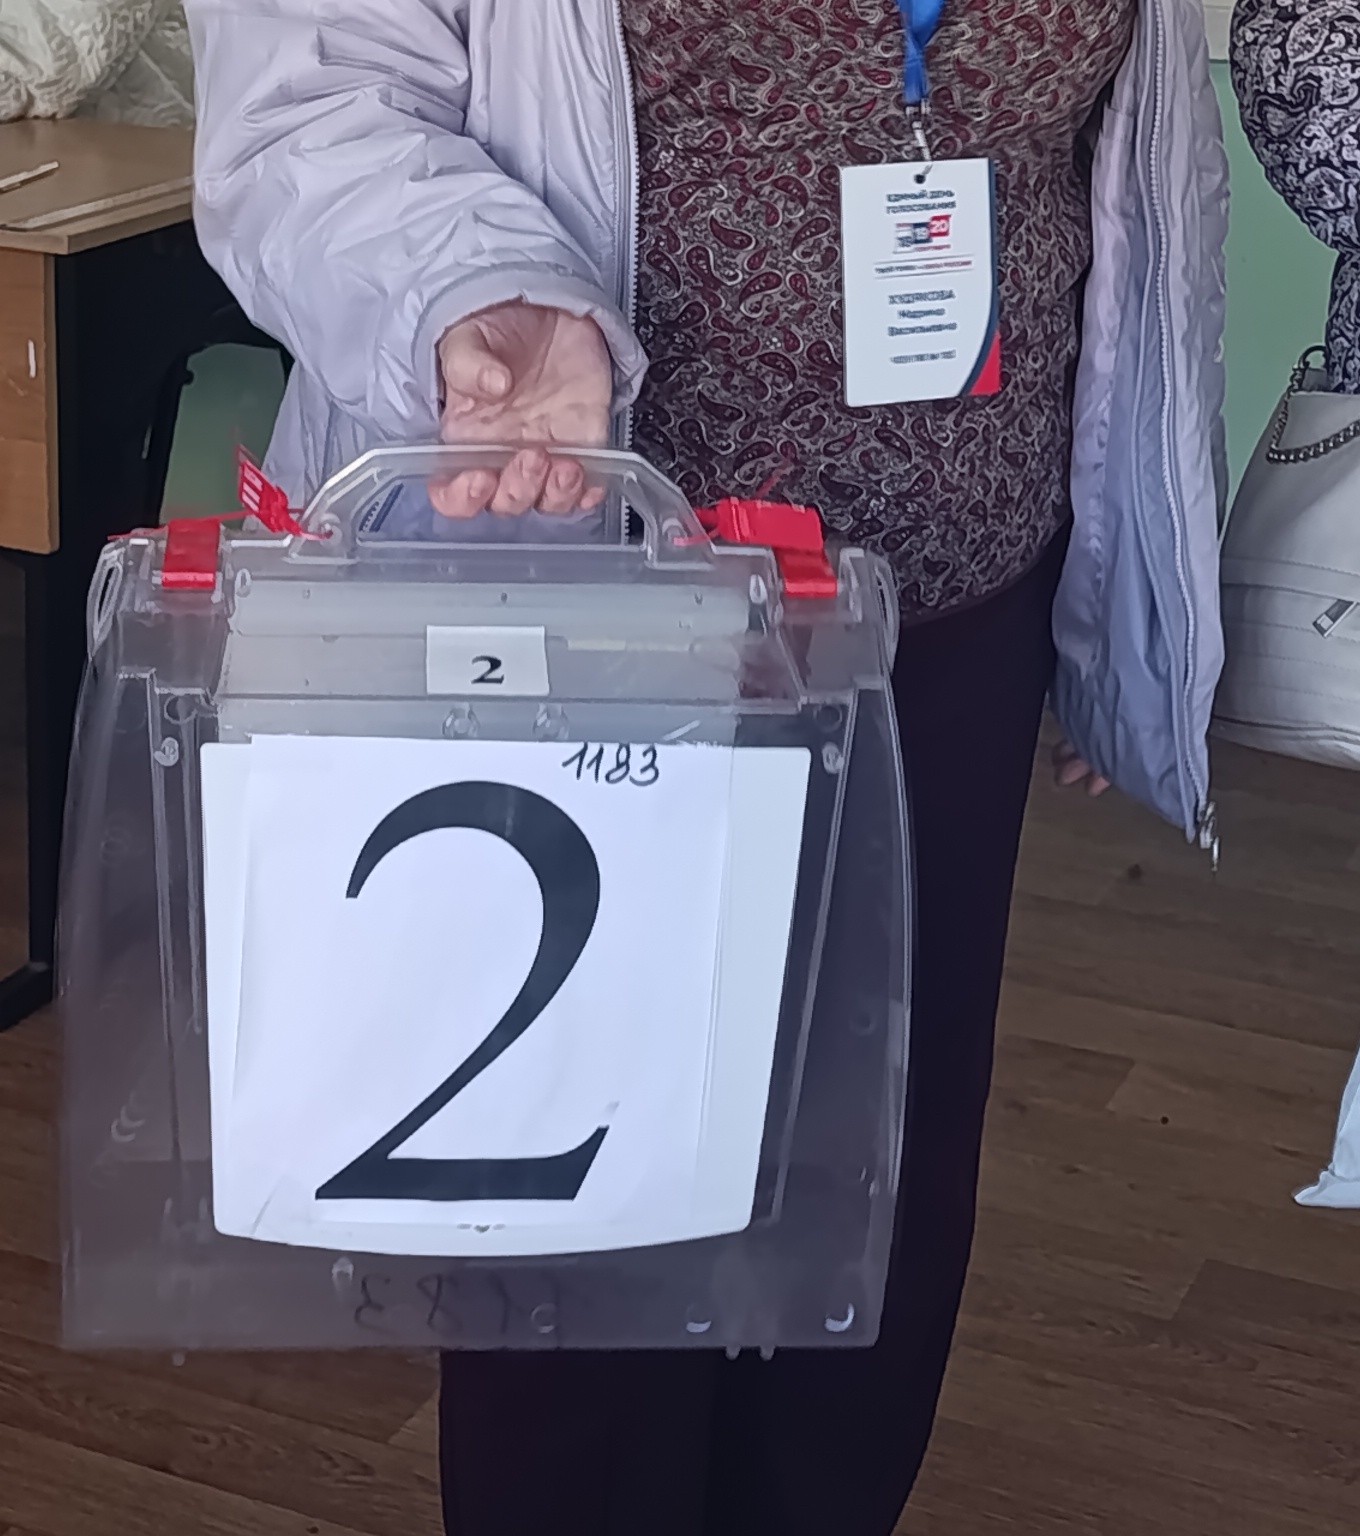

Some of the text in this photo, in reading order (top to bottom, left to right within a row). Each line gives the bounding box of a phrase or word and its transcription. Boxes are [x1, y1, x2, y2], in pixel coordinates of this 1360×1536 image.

[930, 220, 948, 233] 20
[471, 655, 504, 685] 2
[561, 740, 660, 787] 1183
[315, 780, 609, 1200] 2
